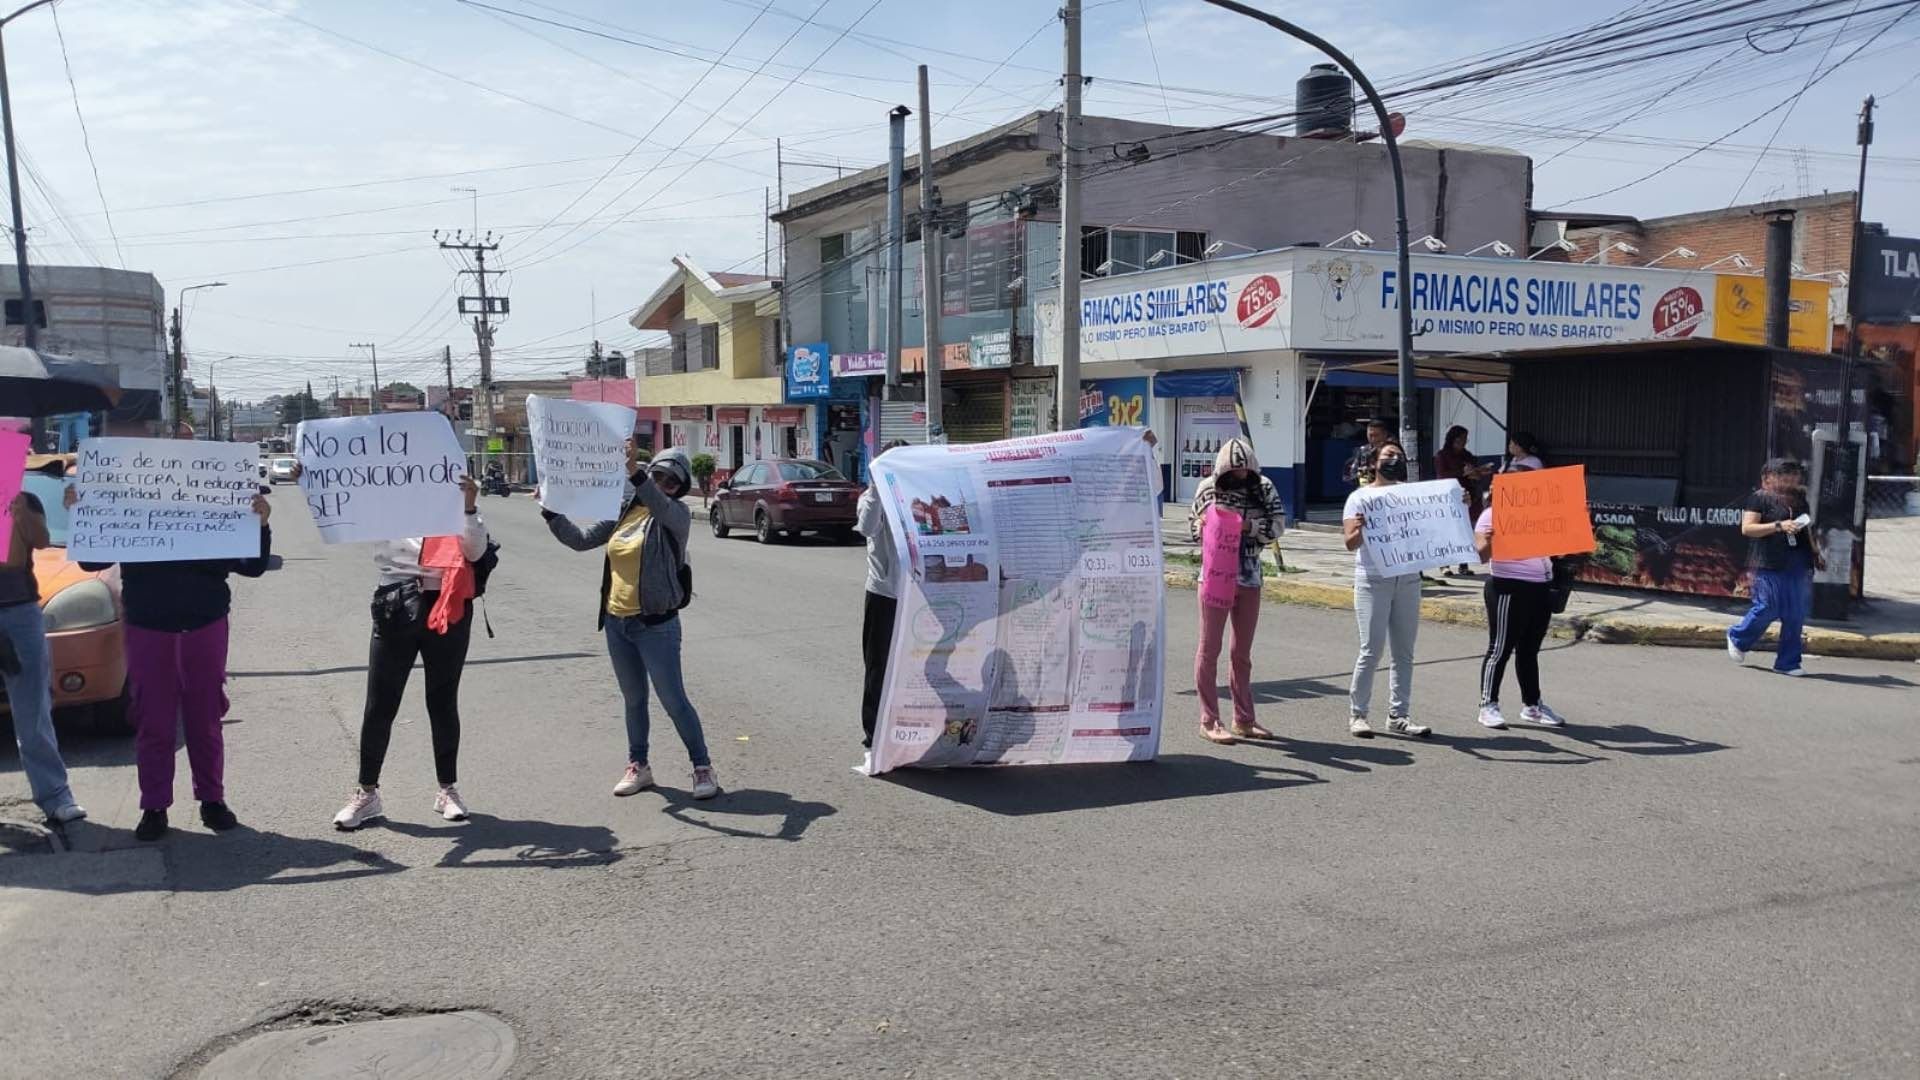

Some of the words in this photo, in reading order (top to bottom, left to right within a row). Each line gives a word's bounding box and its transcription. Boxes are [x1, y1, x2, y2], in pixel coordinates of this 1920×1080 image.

[1079, 292, 1142, 327] RMACIAS
[1146, 280, 1227, 321] SIMILARES
[1242, 286, 1273, 315] 75%
[1382, 271, 1519, 315] FRMACIAS
[1526, 278, 1641, 321] SIMILARES
[1659, 299, 1694, 327] 75%
[1096, 329, 1122, 342] MISMO
[1123, 327, 1146, 339] PERO
[1148, 325, 1166, 337] MAS
[1439, 318, 1485, 335] MISMO
[1489, 321, 1524, 336] PERO
[1529, 323, 1557, 337] MAS
[302, 431, 338, 459] No
[349, 434, 367, 455] a
[380, 426, 408, 455] la
[83, 451, 122, 468] Mas
[133, 452, 153, 469] de
[161, 458, 183, 470] un
[234, 456, 257, 473] sin
[430, 455, 462, 485] de
[186, 473, 200, 489] la
[93, 486, 161, 504] seguridad
[171, 488, 191, 503] de
[308, 491, 350, 518] SEP
[1362, 495, 1383, 513] No
[124, 508, 142, 519] no
[203, 511, 248, 523] seguir
[1365, 514, 1383, 530] de
[1387, 509, 1431, 528] regreso
[1595, 513, 1635, 525] ASADA
[1657, 507, 1686, 523] POLLO
[1687, 507, 1704, 524] AL
[76, 519, 92, 530] en
[100, 519, 141, 534] pausa
[1368, 526, 1420, 545] maestra
[1381, 547, 1424, 568] Liliana
